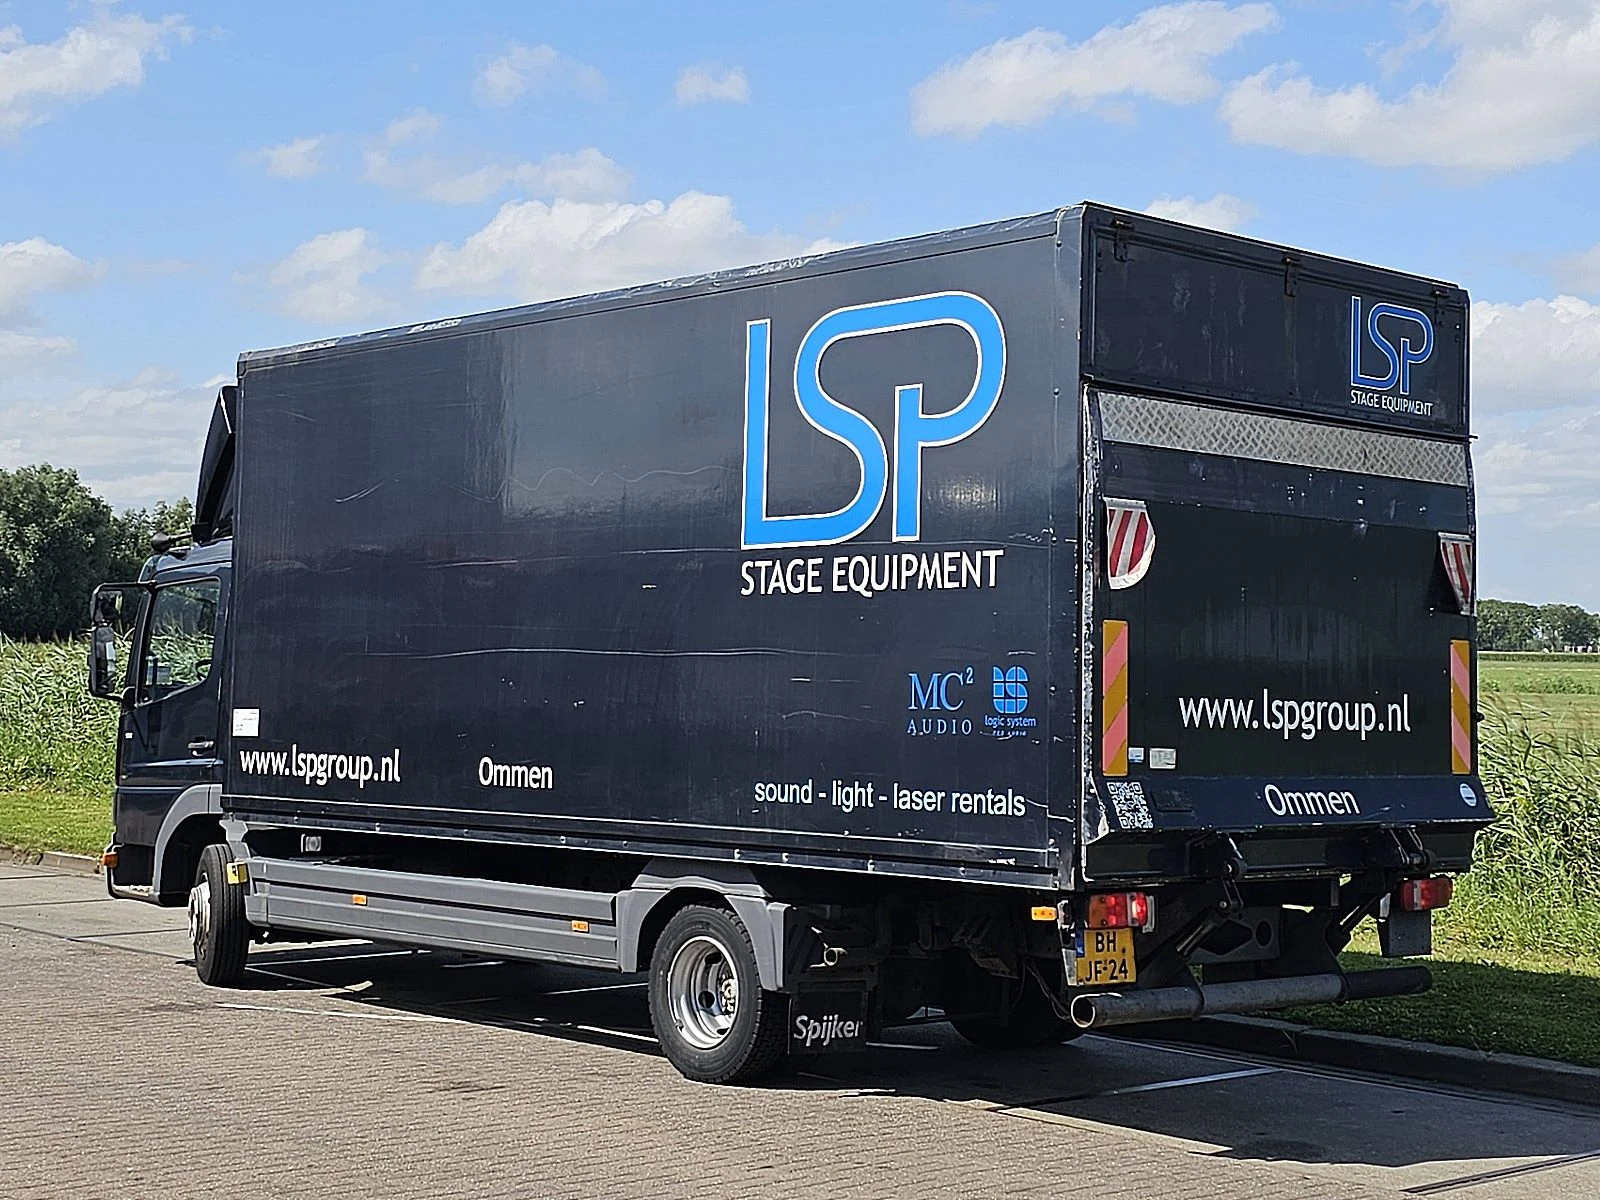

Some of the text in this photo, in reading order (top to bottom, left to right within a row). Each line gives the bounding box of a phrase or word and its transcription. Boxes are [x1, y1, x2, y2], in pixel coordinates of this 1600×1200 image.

[1351, 295, 1434, 395] LSP
[741, 290, 1006, 550] LSP
[1350, 390, 1434, 416] STAGE EQUIPMENT
[740, 549, 1005, 598] STAGE EQUIPMENT
[907, 718, 972, 735] AUDIO
[984, 714, 1037, 729] logic system
[1178, 688, 1411, 740] www.lspgroup.nl
[239, 743, 401, 789] www.lspgroup.nl
[478, 756, 553, 789] Ommen
[754, 779, 813, 804] sound
[831, 780, 874, 813] light
[893, 783, 946, 811] laser
[951, 788, 1026, 816] rentals
[1264, 784, 1361, 816] Ommen
[1095, 931, 1117, 953] BH
[793, 1013, 864, 1047] Spijker
